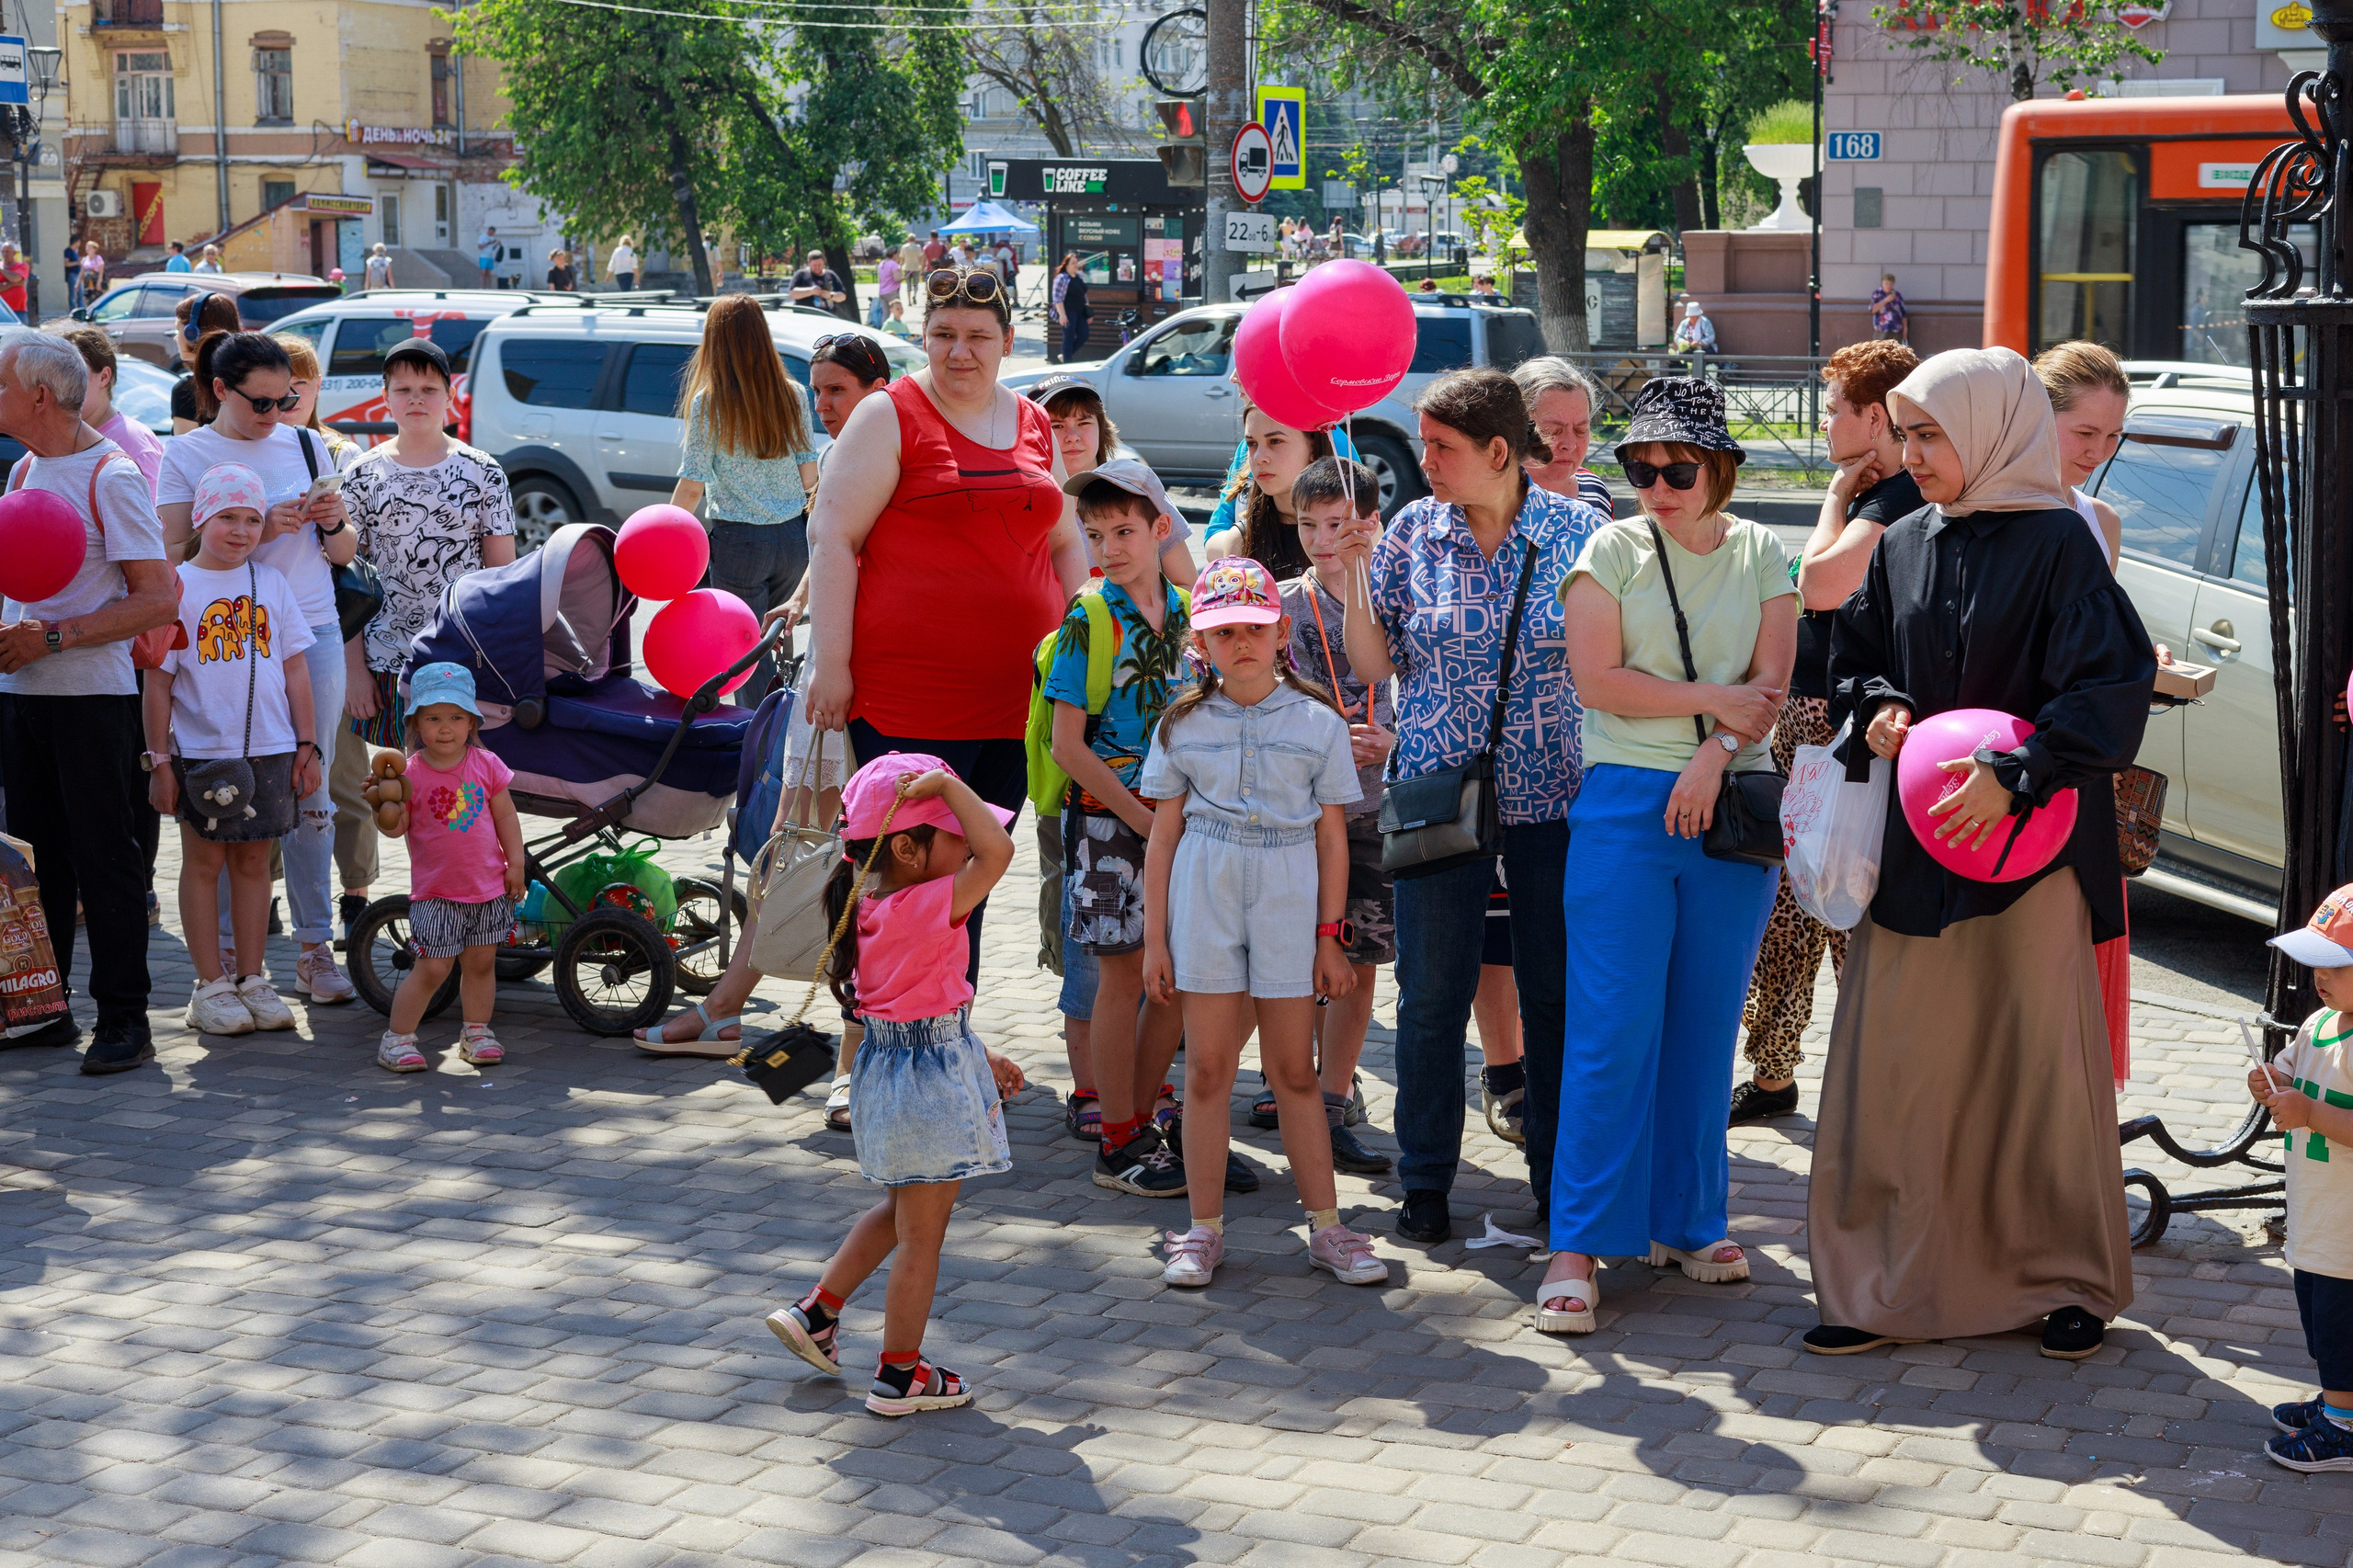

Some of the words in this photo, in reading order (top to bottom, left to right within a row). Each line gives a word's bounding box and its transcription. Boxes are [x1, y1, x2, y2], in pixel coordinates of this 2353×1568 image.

[362, 126, 396, 144] ДЕНЬ
[404, 128, 436, 144] НОЧЬ
[436, 129, 451, 144] 24
[1835, 134, 1874, 158] 168
[1055, 167, 1108, 181] COFFEE
[1055, 180, 1086, 193] LIKE
[429, 504, 465, 532] WOW
[3, 931, 28, 944] GOLD
